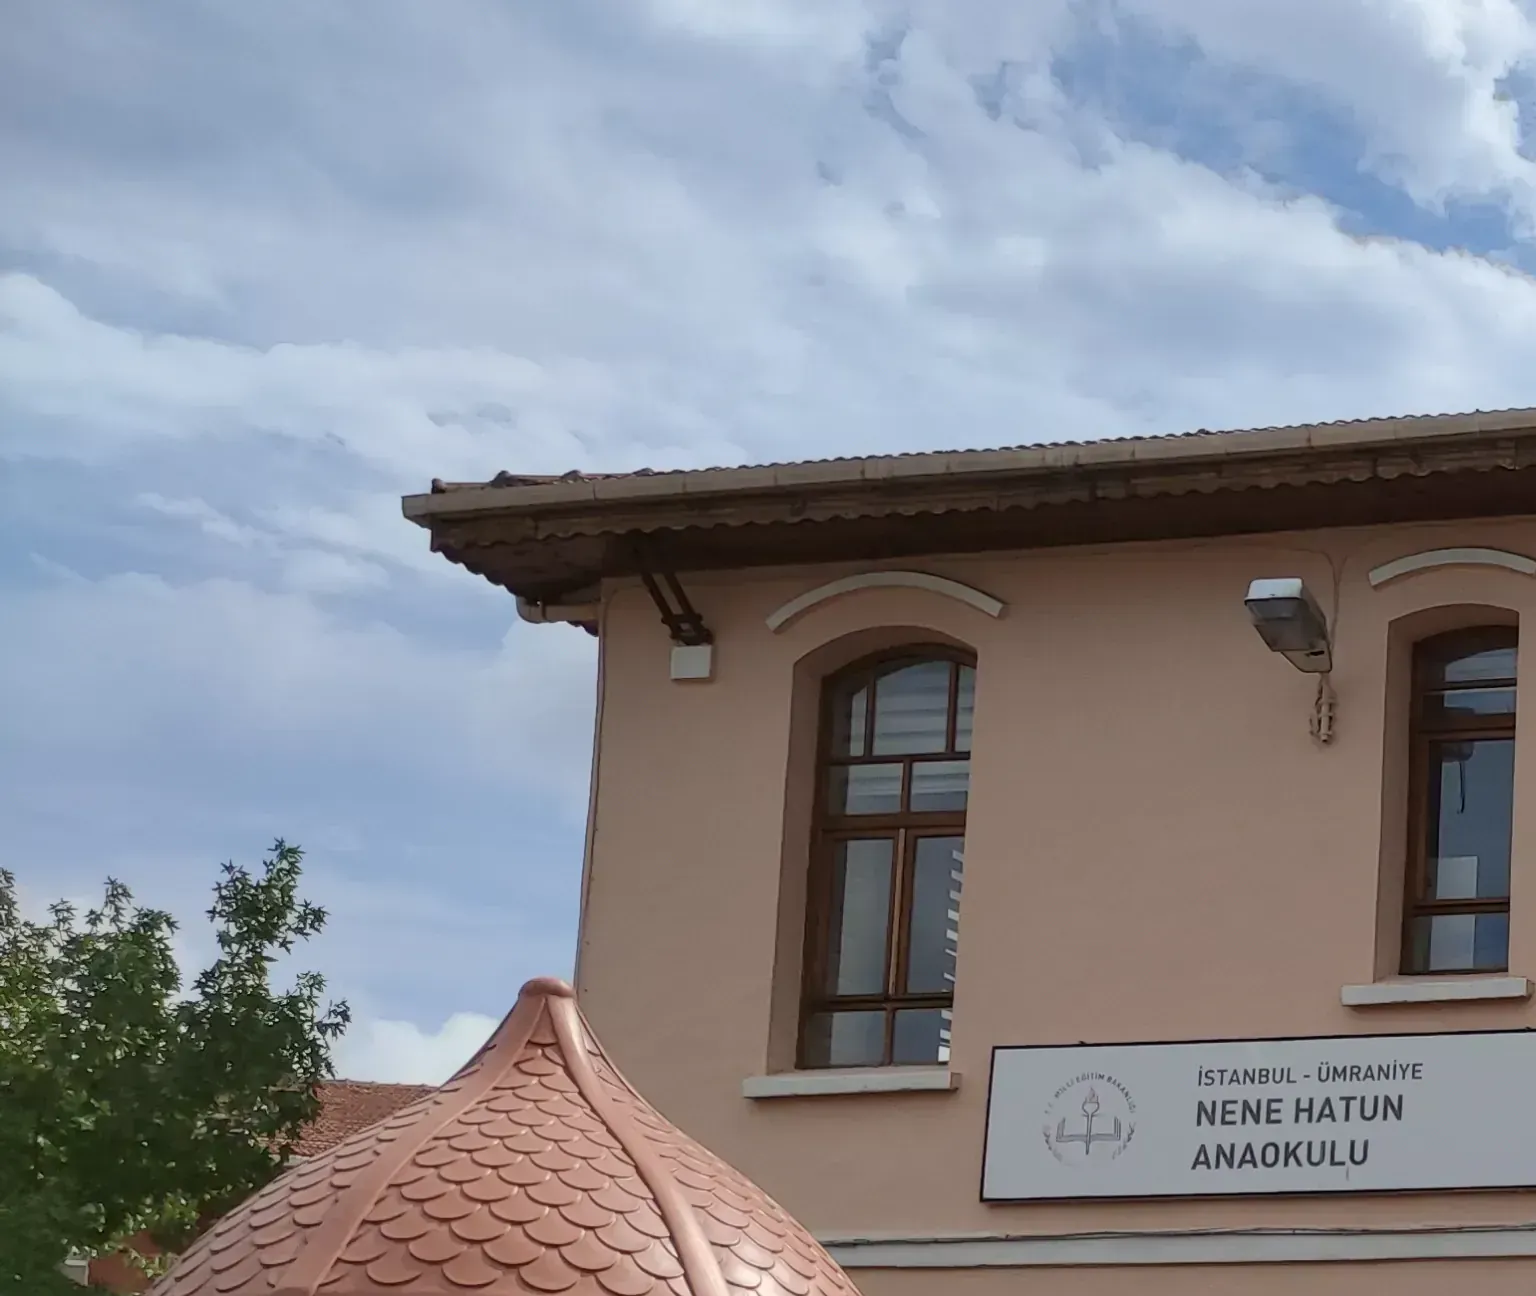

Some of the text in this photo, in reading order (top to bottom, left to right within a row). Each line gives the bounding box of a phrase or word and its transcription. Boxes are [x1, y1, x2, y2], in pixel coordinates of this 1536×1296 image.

[1198, 1066, 1297, 1086] İSTANBUL
[1317, 1060, 1424, 1082] ÜMRANİYE
[1196, 1094, 1403, 1127] NENE HATUN
[1191, 1139, 1369, 1170] ANAOKULU
